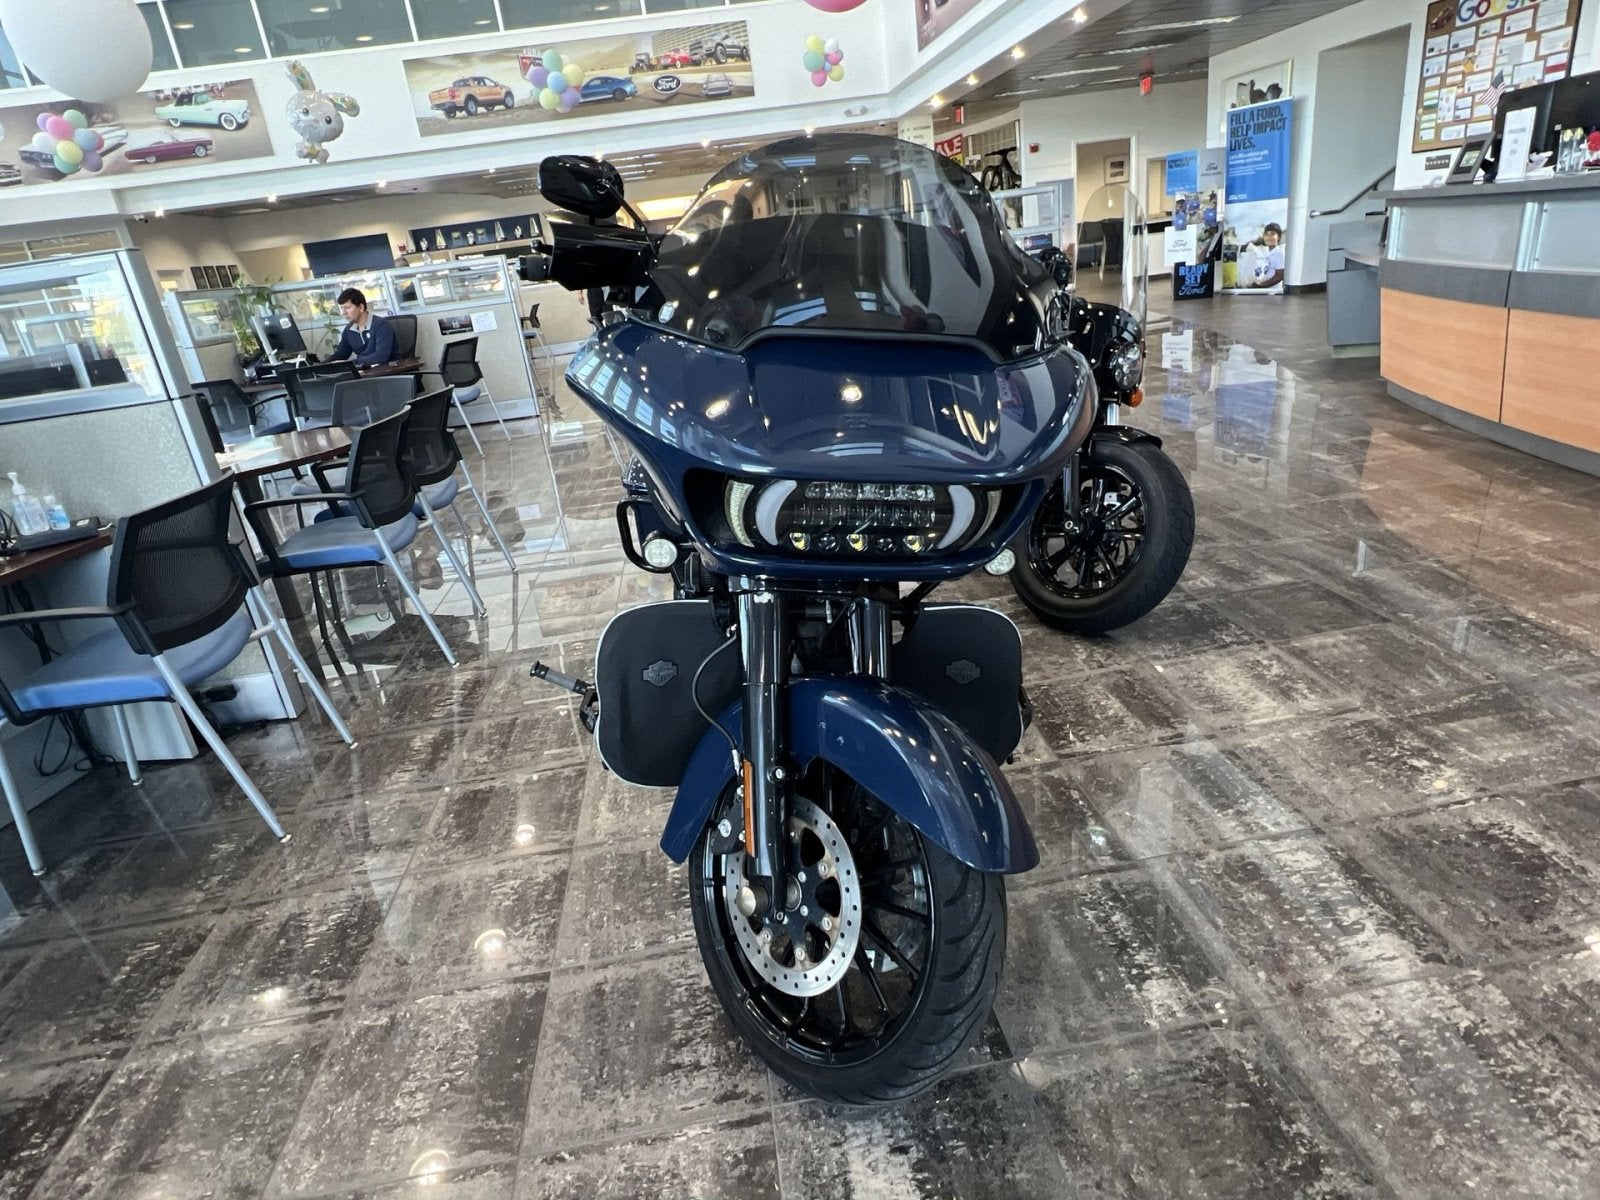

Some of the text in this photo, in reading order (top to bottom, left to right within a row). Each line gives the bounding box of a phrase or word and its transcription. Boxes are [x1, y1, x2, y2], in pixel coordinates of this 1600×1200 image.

[657, 77, 677, 90] Ford
[1230, 105, 1283, 126] FILL A FORD.
[1230, 117, 1287, 138] HELP IMPACT
[935, 134, 962, 158] ALE
[1229, 137, 1256, 151] LIVES.
[1178, 263, 1209, 277] READY
[1184, 273, 1201, 285] SET
[1178, 283, 1208, 296] Ford
